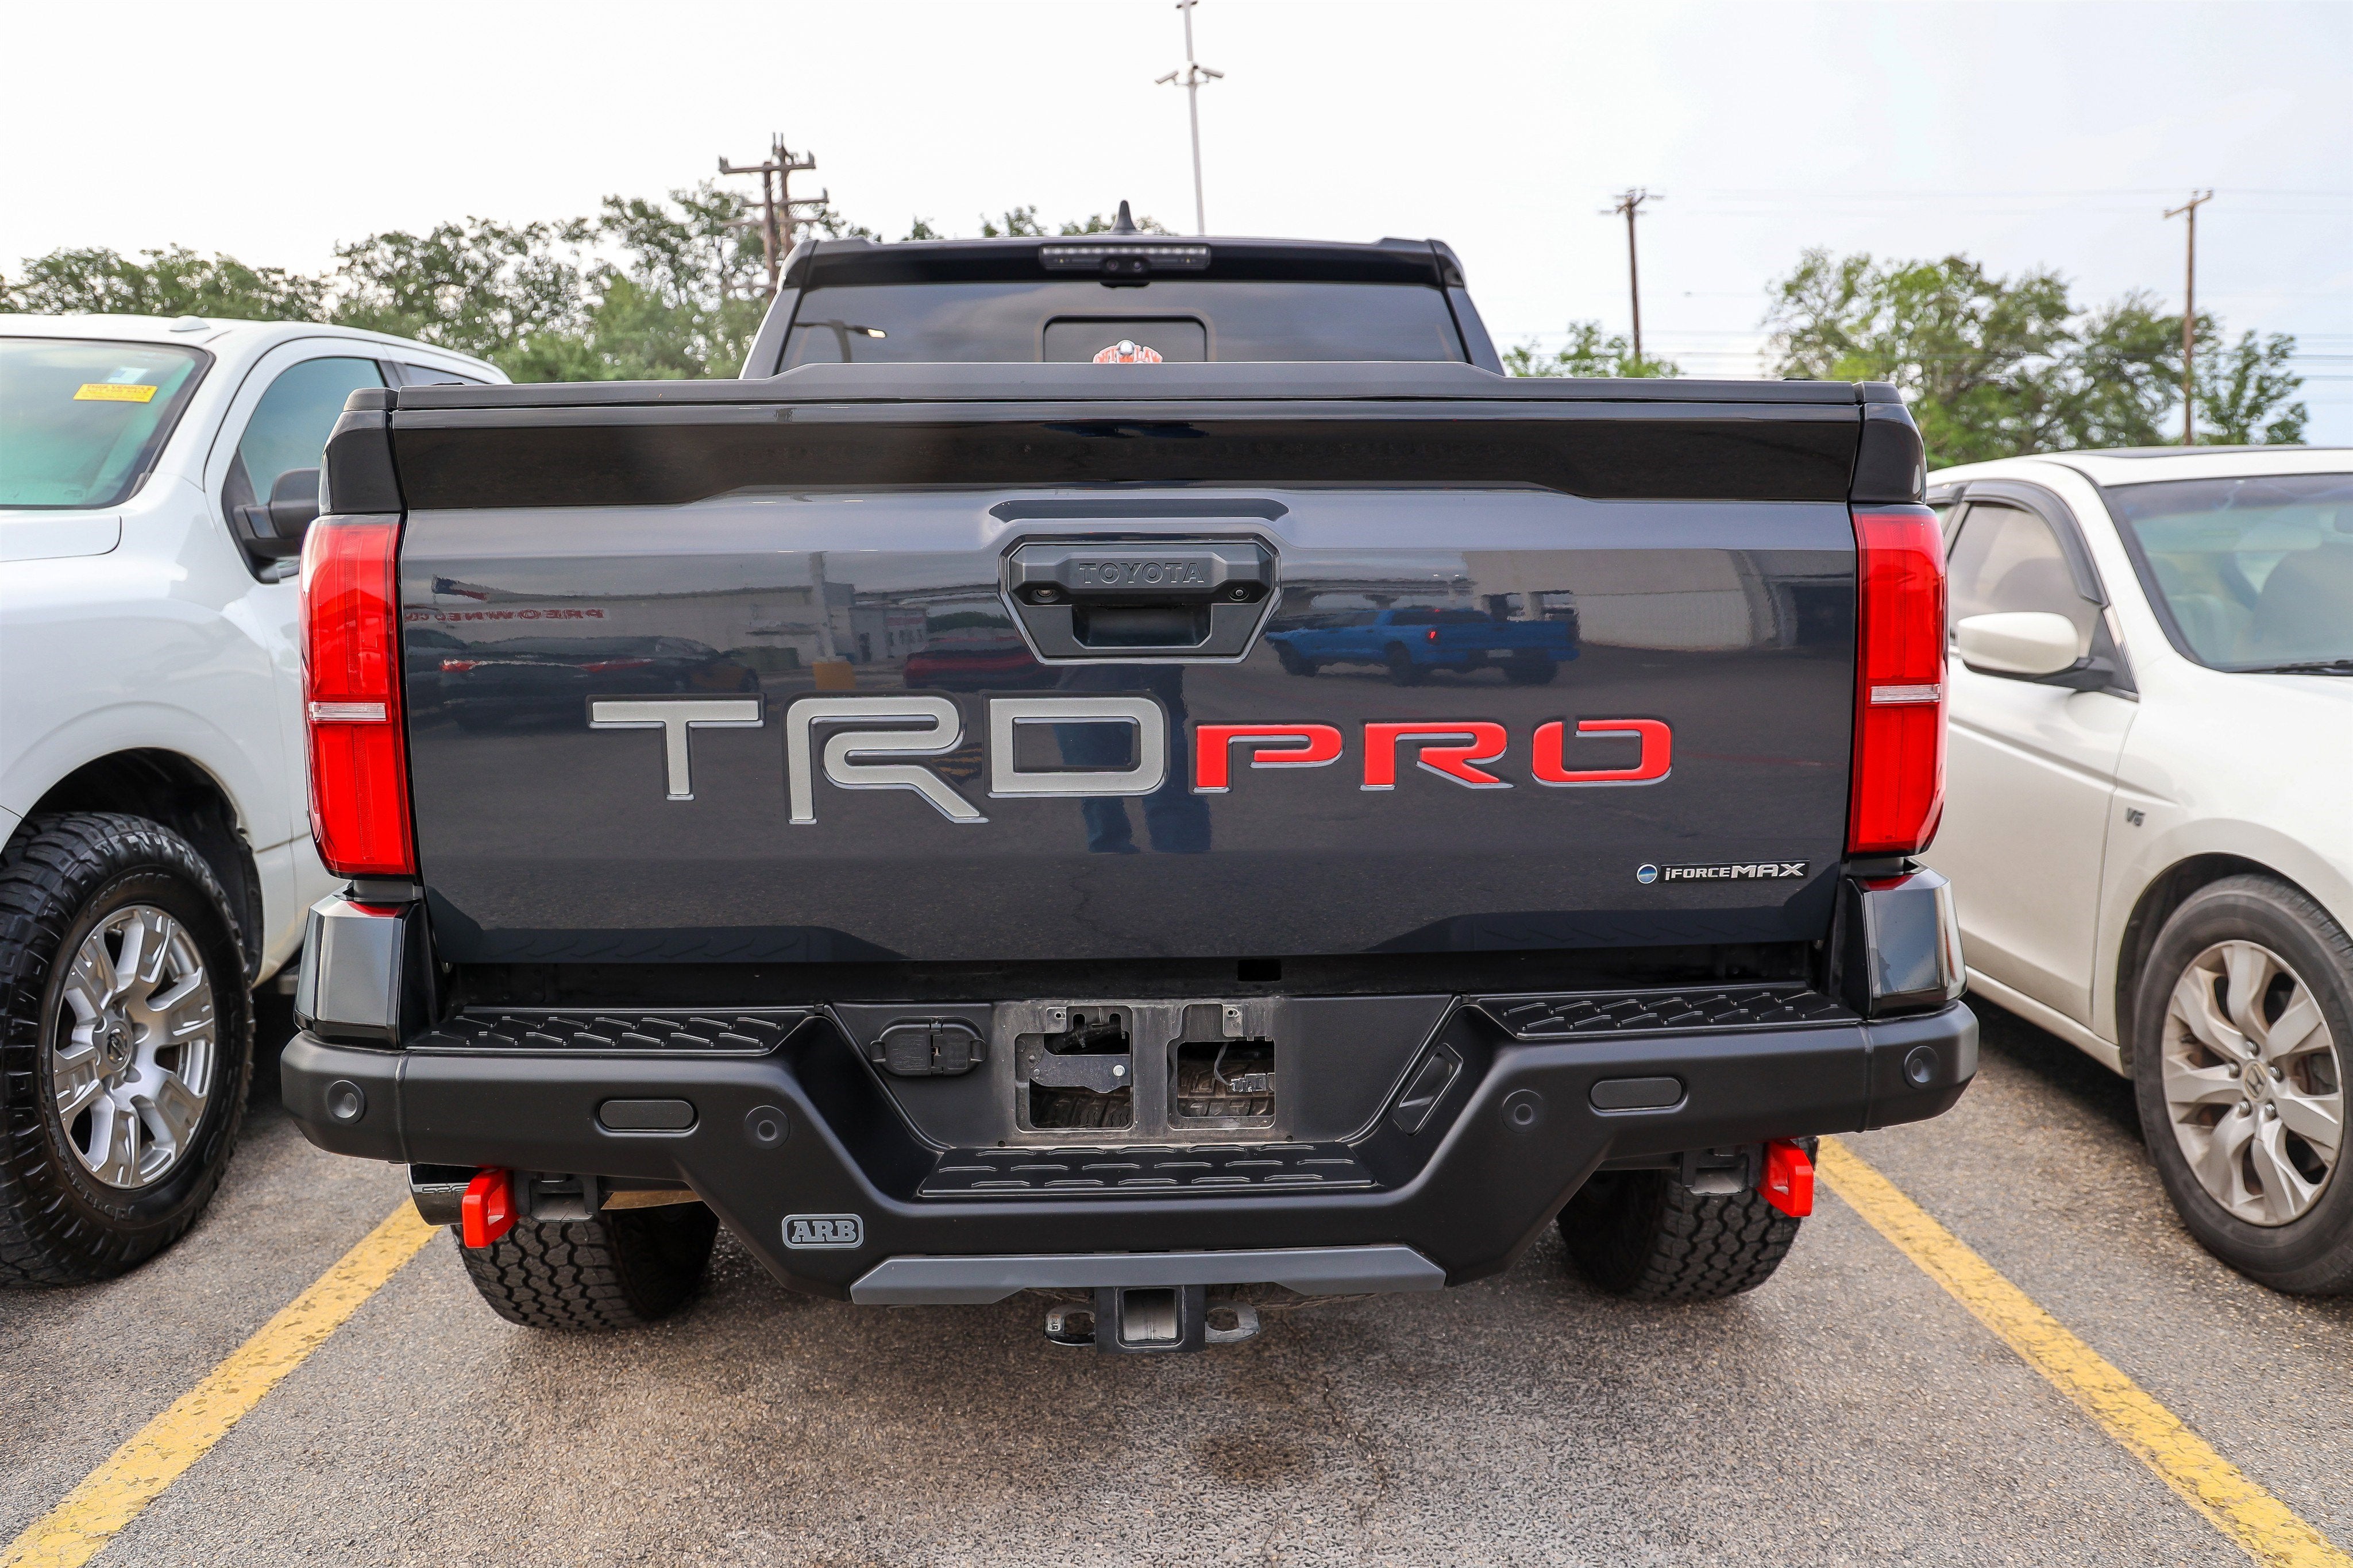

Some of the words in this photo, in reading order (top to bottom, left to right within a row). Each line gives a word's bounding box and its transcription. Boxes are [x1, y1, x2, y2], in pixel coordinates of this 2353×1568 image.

[1078, 562, 1205, 584] TOYOTA
[587, 696, 1168, 825] TRD
[1193, 719, 1673, 793] PRO
[792, 1221, 857, 1242] ARB
